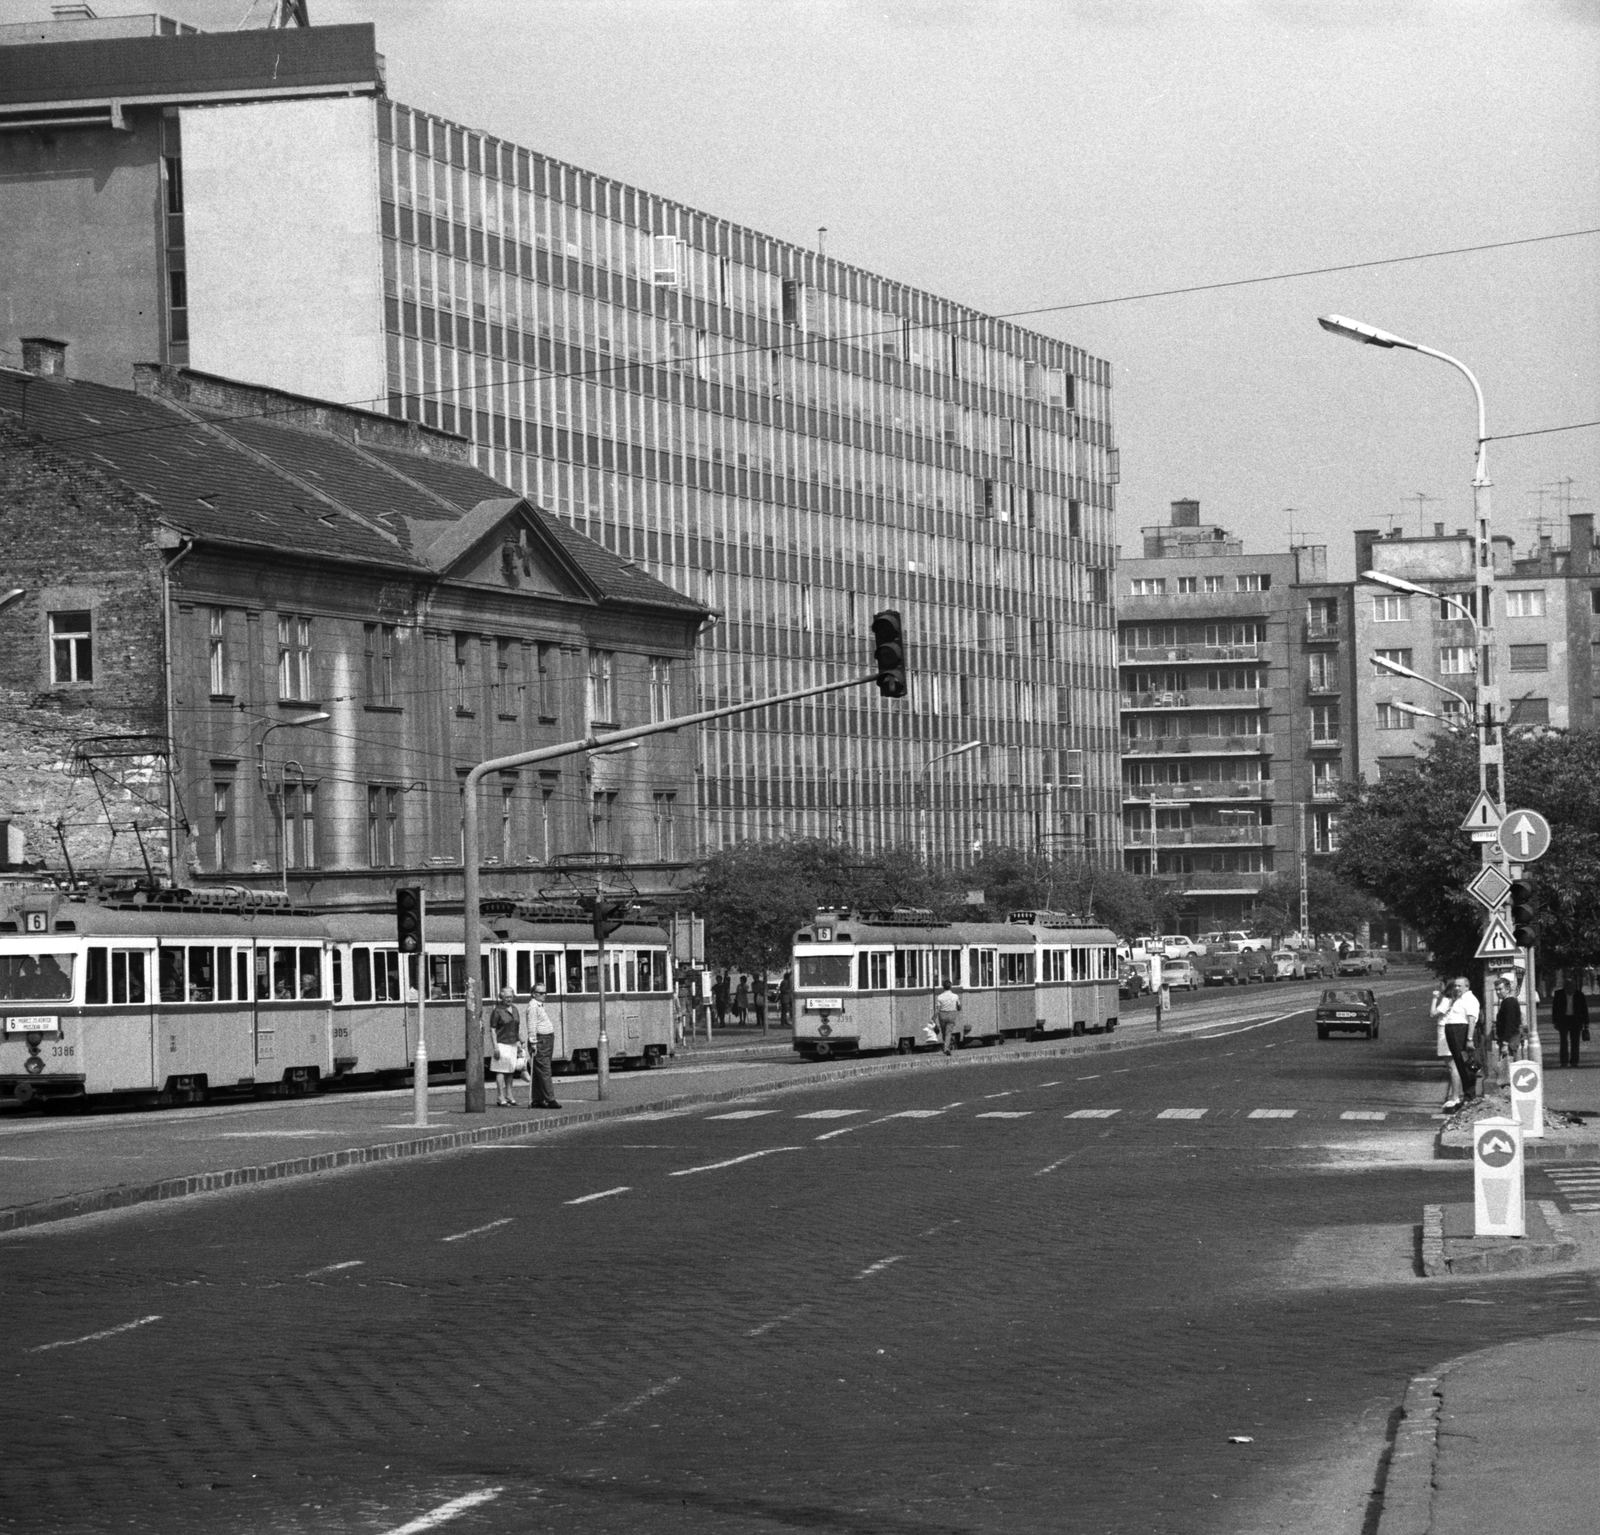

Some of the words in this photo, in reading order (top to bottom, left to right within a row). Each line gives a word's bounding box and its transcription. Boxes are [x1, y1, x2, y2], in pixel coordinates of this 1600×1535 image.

[33, 915, 41, 929] 6
[822, 928, 828, 939] 6
[10, 1018, 16, 1029] 6
[52, 1046, 75, 1058] 3386
